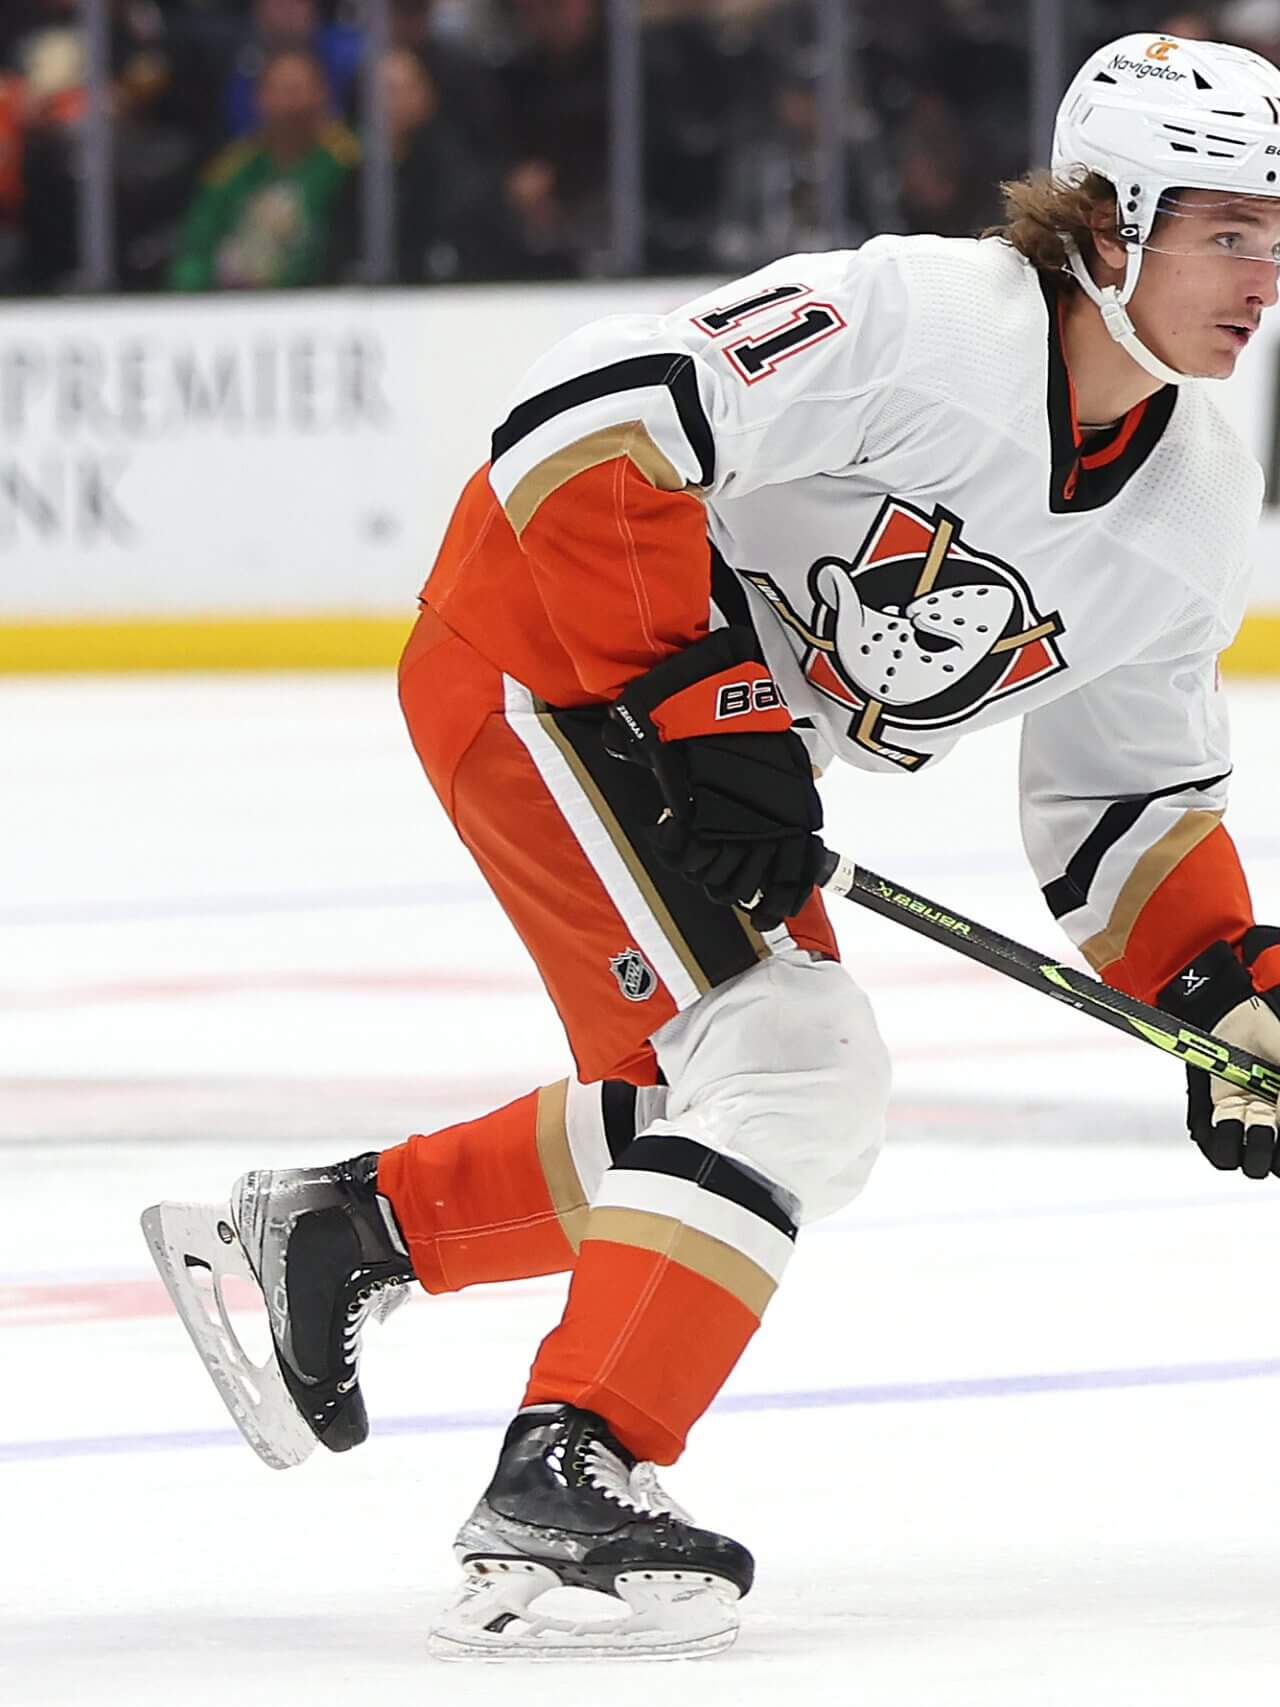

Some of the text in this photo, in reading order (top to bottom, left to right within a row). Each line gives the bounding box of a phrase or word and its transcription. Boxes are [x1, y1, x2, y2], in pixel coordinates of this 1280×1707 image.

[1108, 54, 1187, 82] Navigator
[690, 283, 848, 387] 11
[0, 332, 390, 437] PREMIER
[715, 678, 788, 720] BA
[890, 892, 973, 937] BAUER
